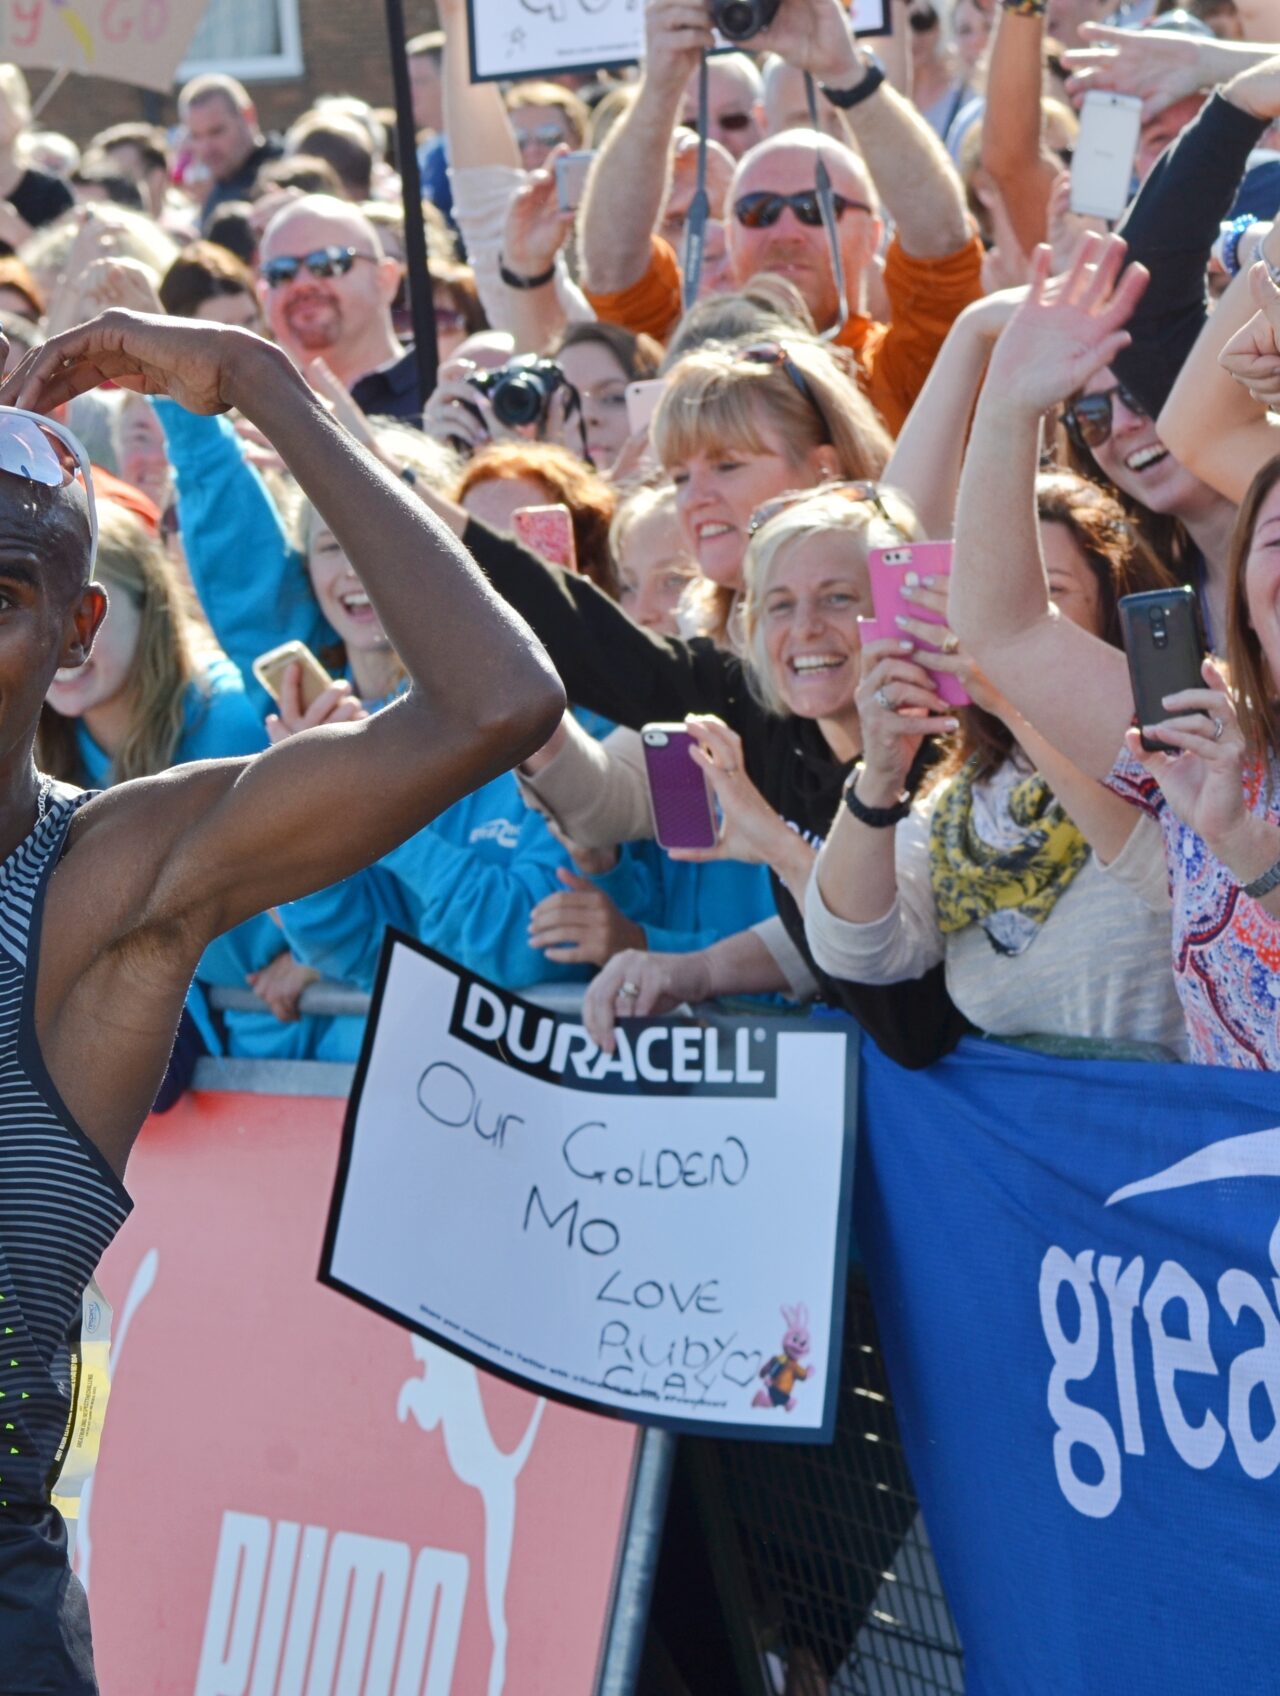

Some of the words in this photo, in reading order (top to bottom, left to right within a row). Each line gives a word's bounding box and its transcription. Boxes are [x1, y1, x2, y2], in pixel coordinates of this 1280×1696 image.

[416, 1061, 525, 1150] Our
[462, 983, 765, 1084] DURACELL
[1038, 1245, 1280, 1519] grea
[194, 1509, 470, 1696] PUMA
